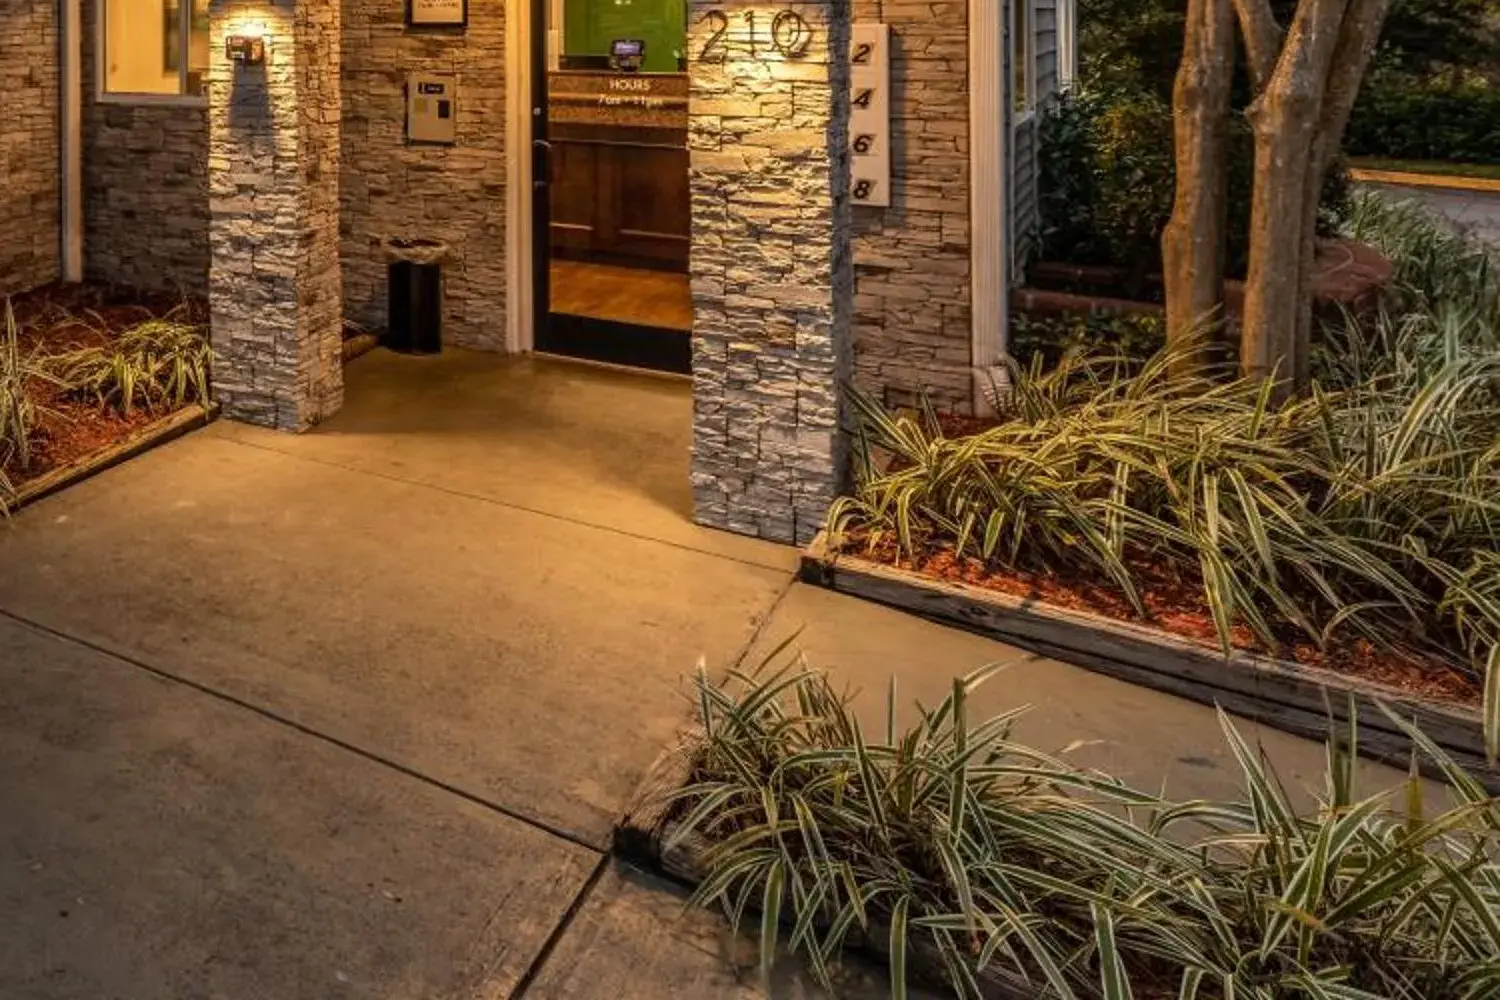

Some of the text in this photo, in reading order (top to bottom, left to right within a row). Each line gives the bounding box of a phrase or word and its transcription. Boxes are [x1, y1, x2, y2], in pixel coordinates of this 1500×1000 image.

[698, 9, 807, 60] 210
[852, 43, 871, 63] 2
[609, 79, 651, 92] HOURS
[851, 89, 873, 109] 4
[853, 135, 873, 153] 6
[853, 181, 871, 199] 8
